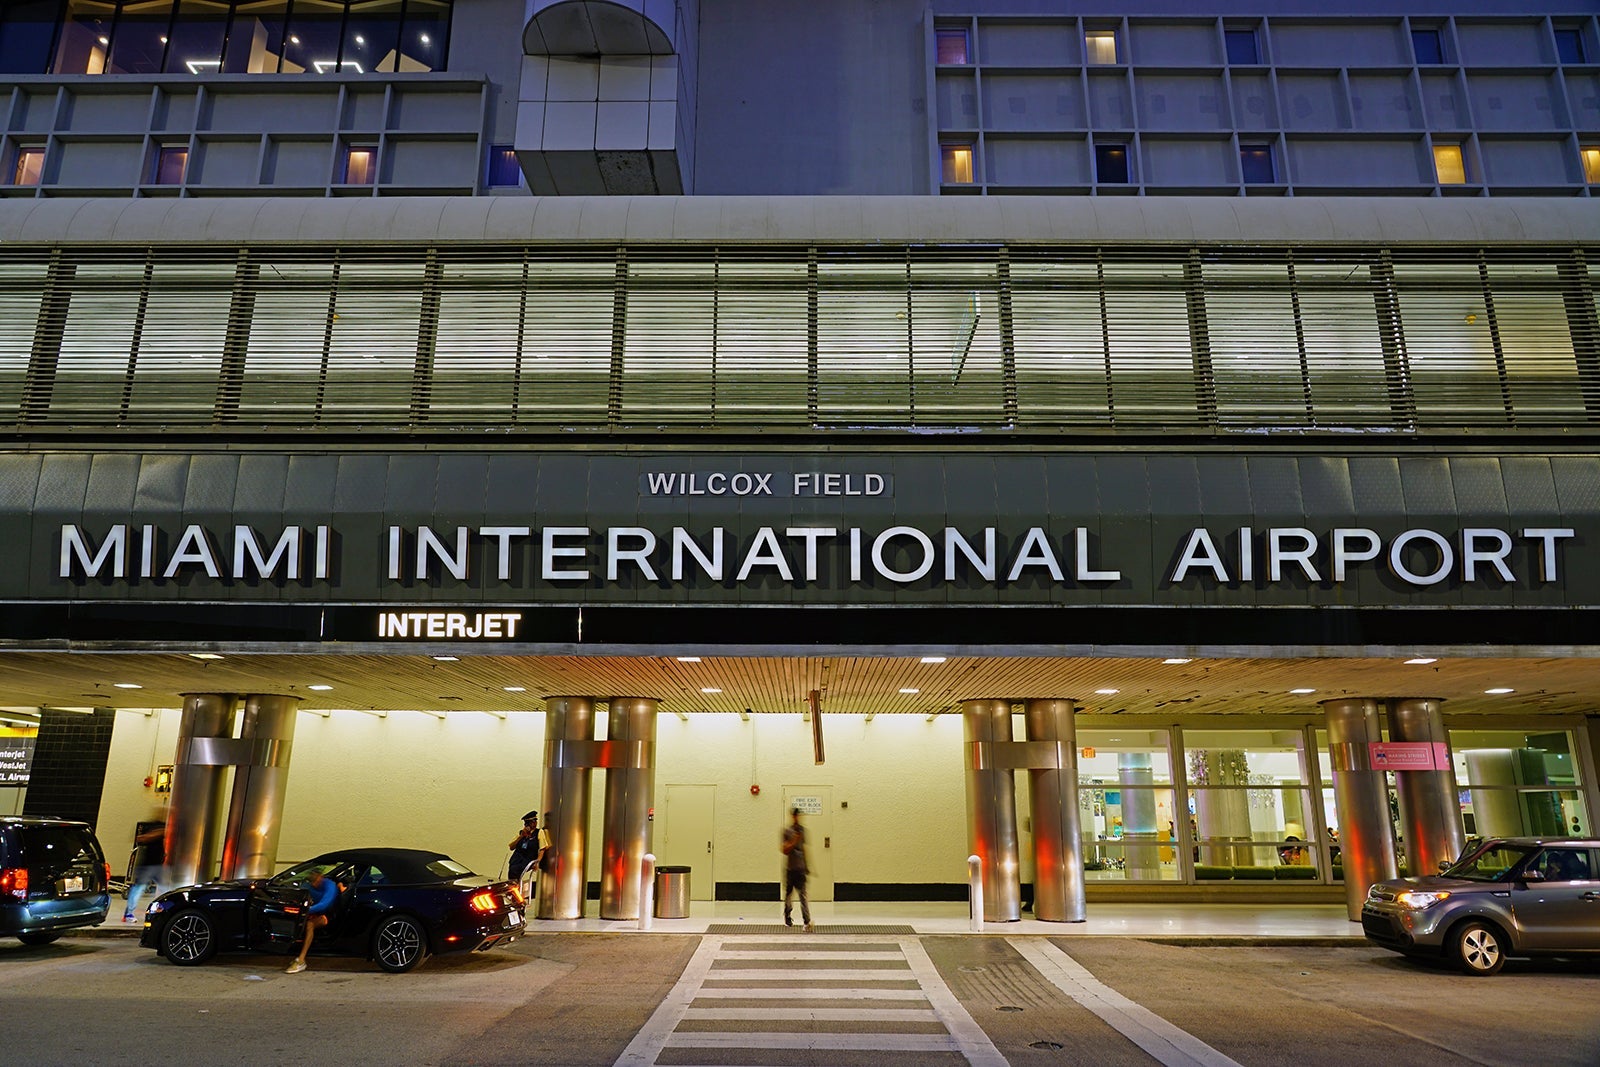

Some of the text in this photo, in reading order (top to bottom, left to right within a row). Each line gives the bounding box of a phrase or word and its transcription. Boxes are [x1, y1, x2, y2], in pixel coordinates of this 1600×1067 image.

[647, 472, 885, 495] WILCOX FIELD
[60, 524, 1576, 585] MIAMI INTERNATIONAL AIRPORT
[378, 613, 521, 638] INTERJET
[0, 750, 25, 760] nterjet
[8, 773, 30, 781] Airwa
